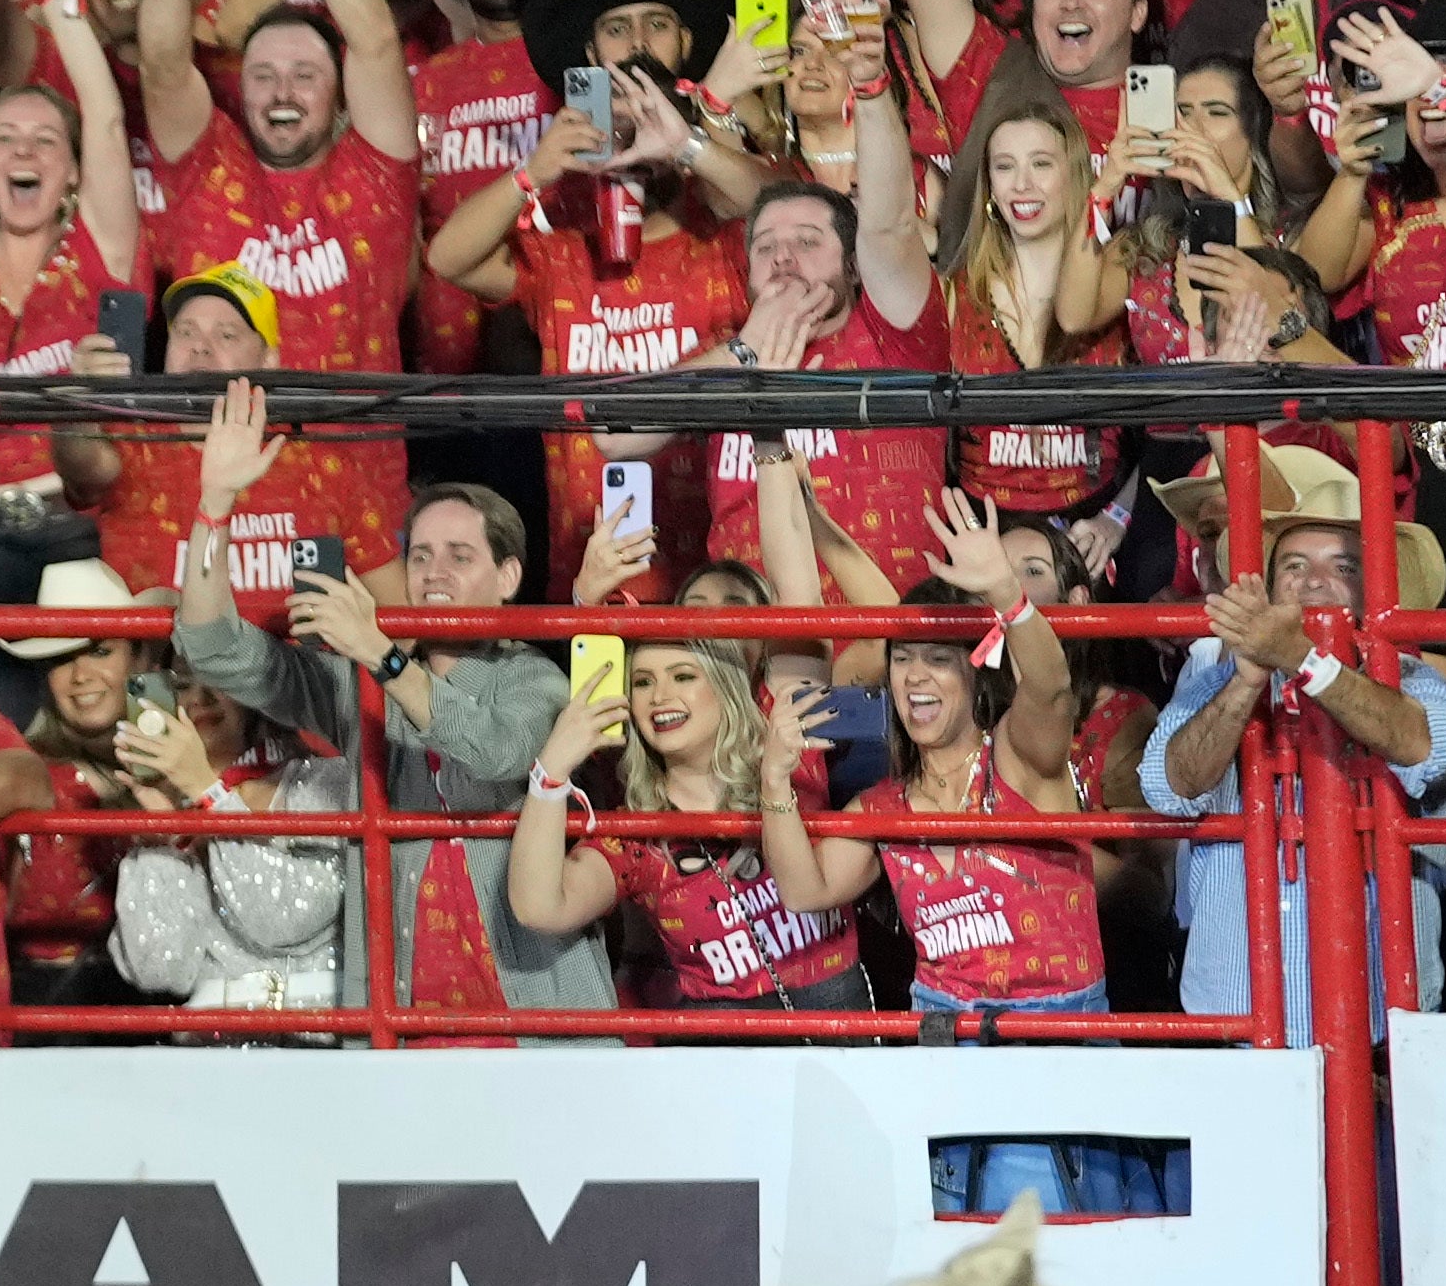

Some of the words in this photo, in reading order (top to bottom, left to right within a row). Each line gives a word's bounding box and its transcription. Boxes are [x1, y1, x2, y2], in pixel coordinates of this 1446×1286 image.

[567, 320, 700, 374] BRAHMA
[988, 430, 1088, 470] BRAHMA
[919, 891, 987, 926] CAMAROTE
[914, 910, 1015, 962] BRAHMA
